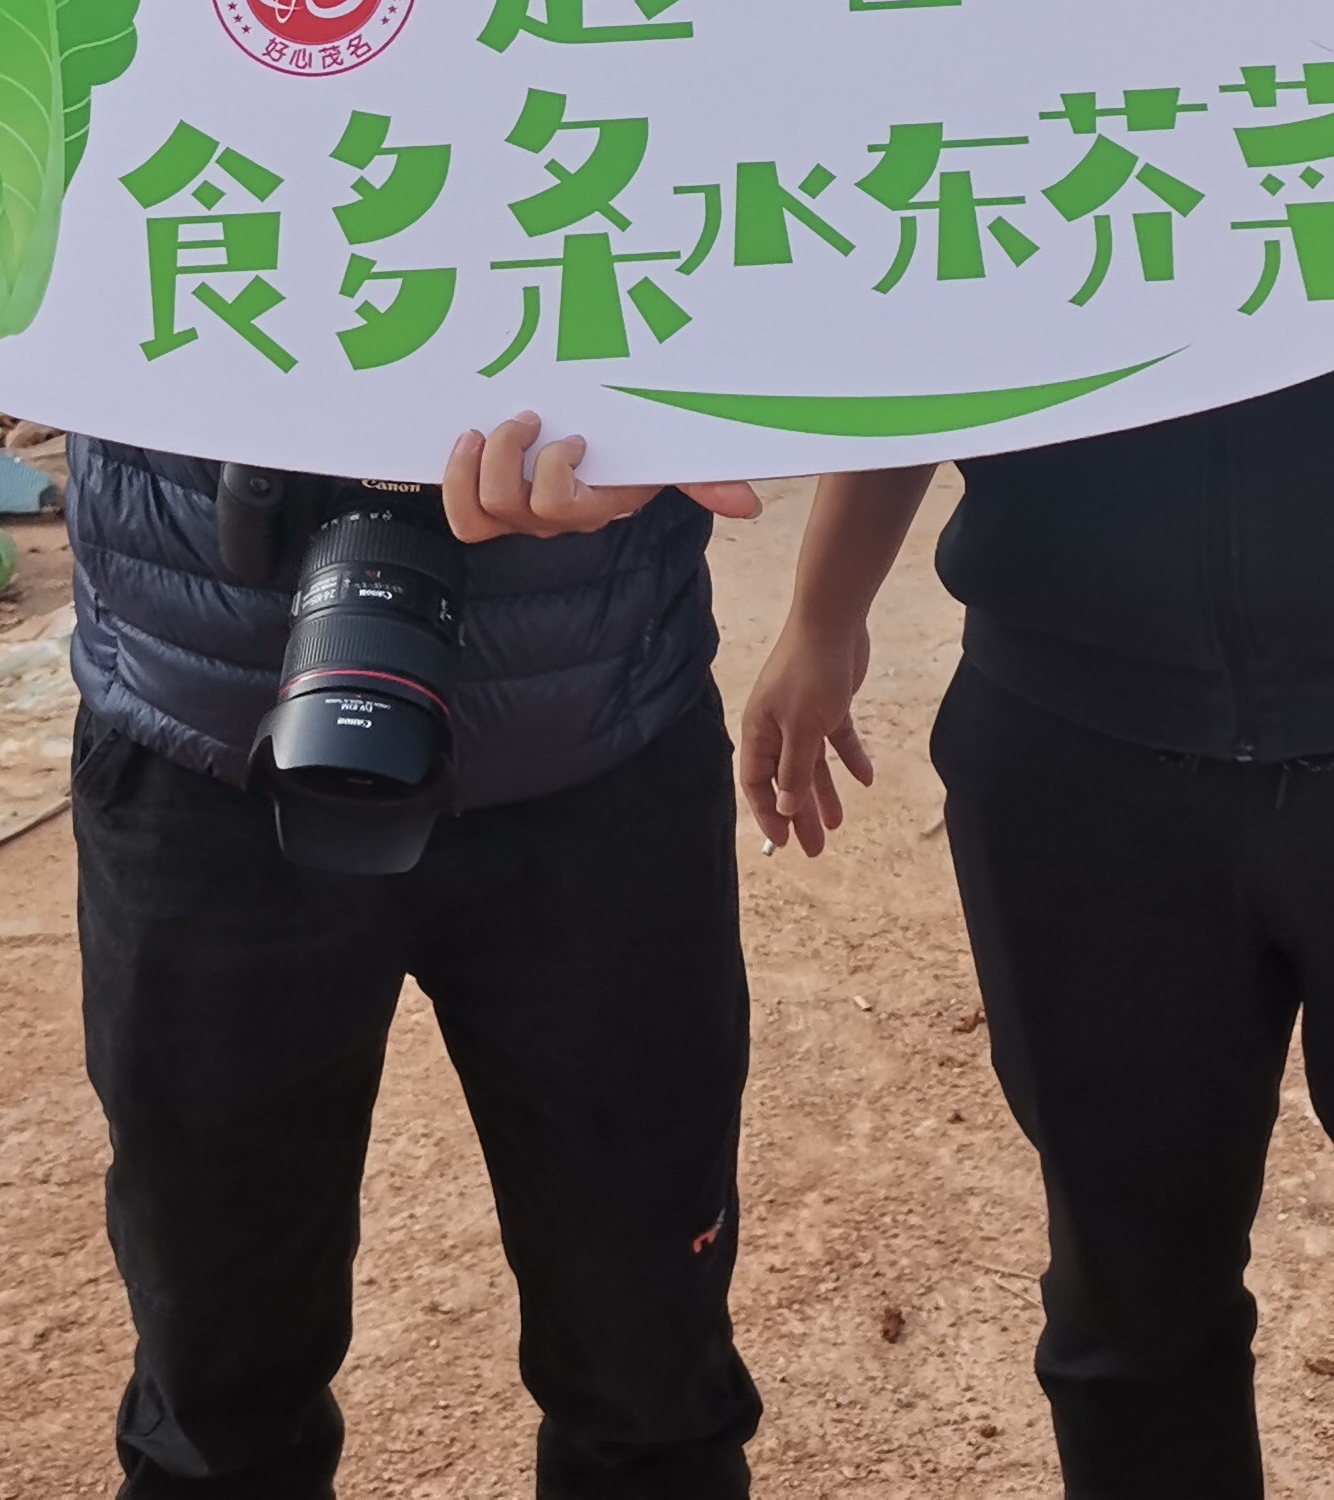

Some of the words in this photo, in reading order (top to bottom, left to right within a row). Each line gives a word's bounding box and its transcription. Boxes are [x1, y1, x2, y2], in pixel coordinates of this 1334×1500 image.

[261, 33, 373, 70] 好心茂名
[361, 479, 421, 493] Canon
